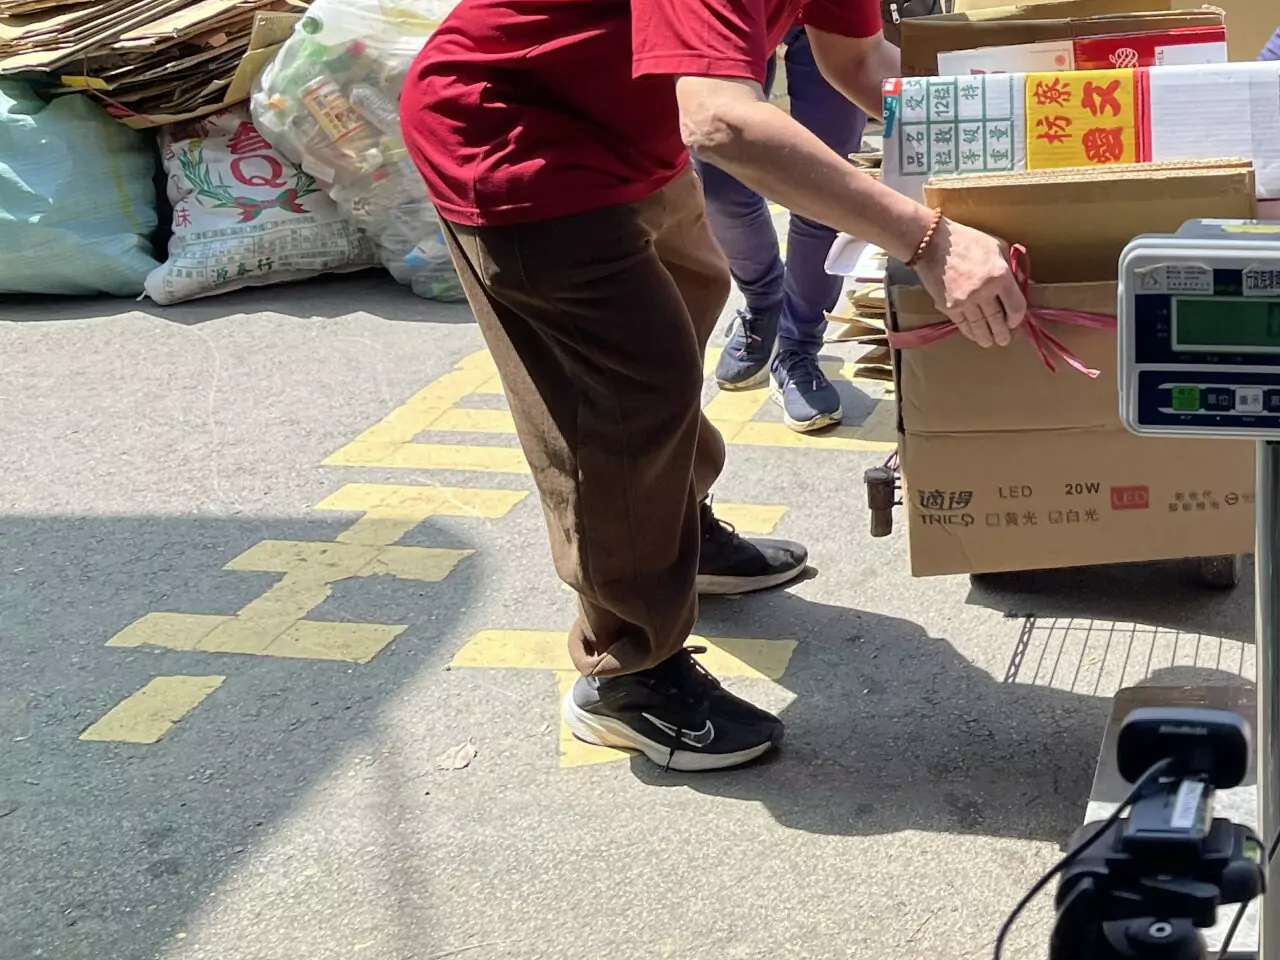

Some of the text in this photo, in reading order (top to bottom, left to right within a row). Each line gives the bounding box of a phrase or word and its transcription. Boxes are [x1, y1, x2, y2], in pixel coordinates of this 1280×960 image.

[933, 86, 953, 168] 粒數 12粒
[1034, 76, 1073, 145] 枋寮
[907, 131, 925, 169] 品名
[961, 125, 981, 166] 等級
[989, 125, 1010, 164] 重量
[998, 481, 1100, 500] LED 20W
[1111, 490, 1148, 506] LED
[1066, 508, 1100, 524] 白光
